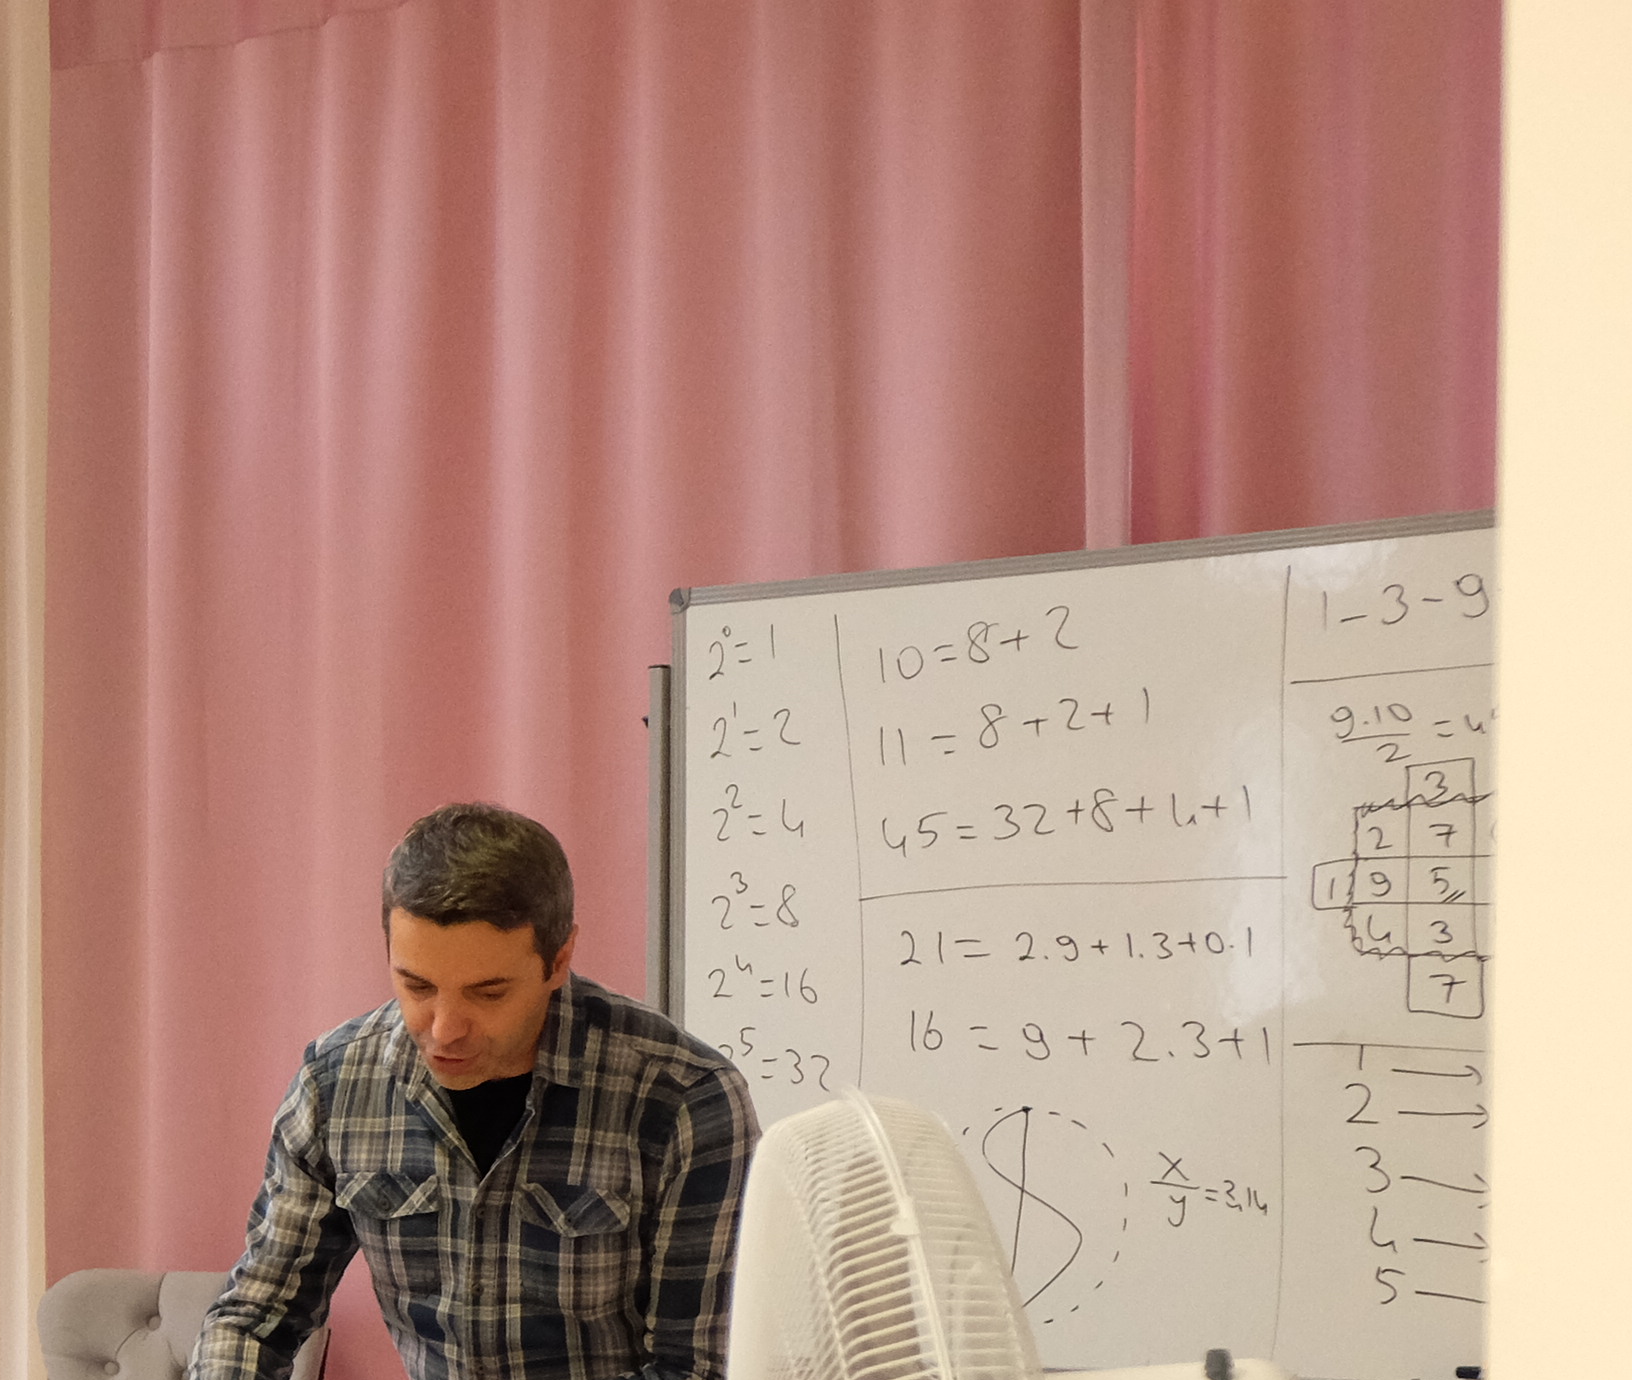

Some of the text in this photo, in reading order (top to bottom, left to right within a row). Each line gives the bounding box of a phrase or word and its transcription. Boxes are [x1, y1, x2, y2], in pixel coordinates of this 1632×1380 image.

[1345, 1082, 1380, 1124] 2
[1354, 1145, 1392, 1194] 3
[1369, 1205, 1398, 1254] 4
[1375, 1265, 1407, 1305] 5
